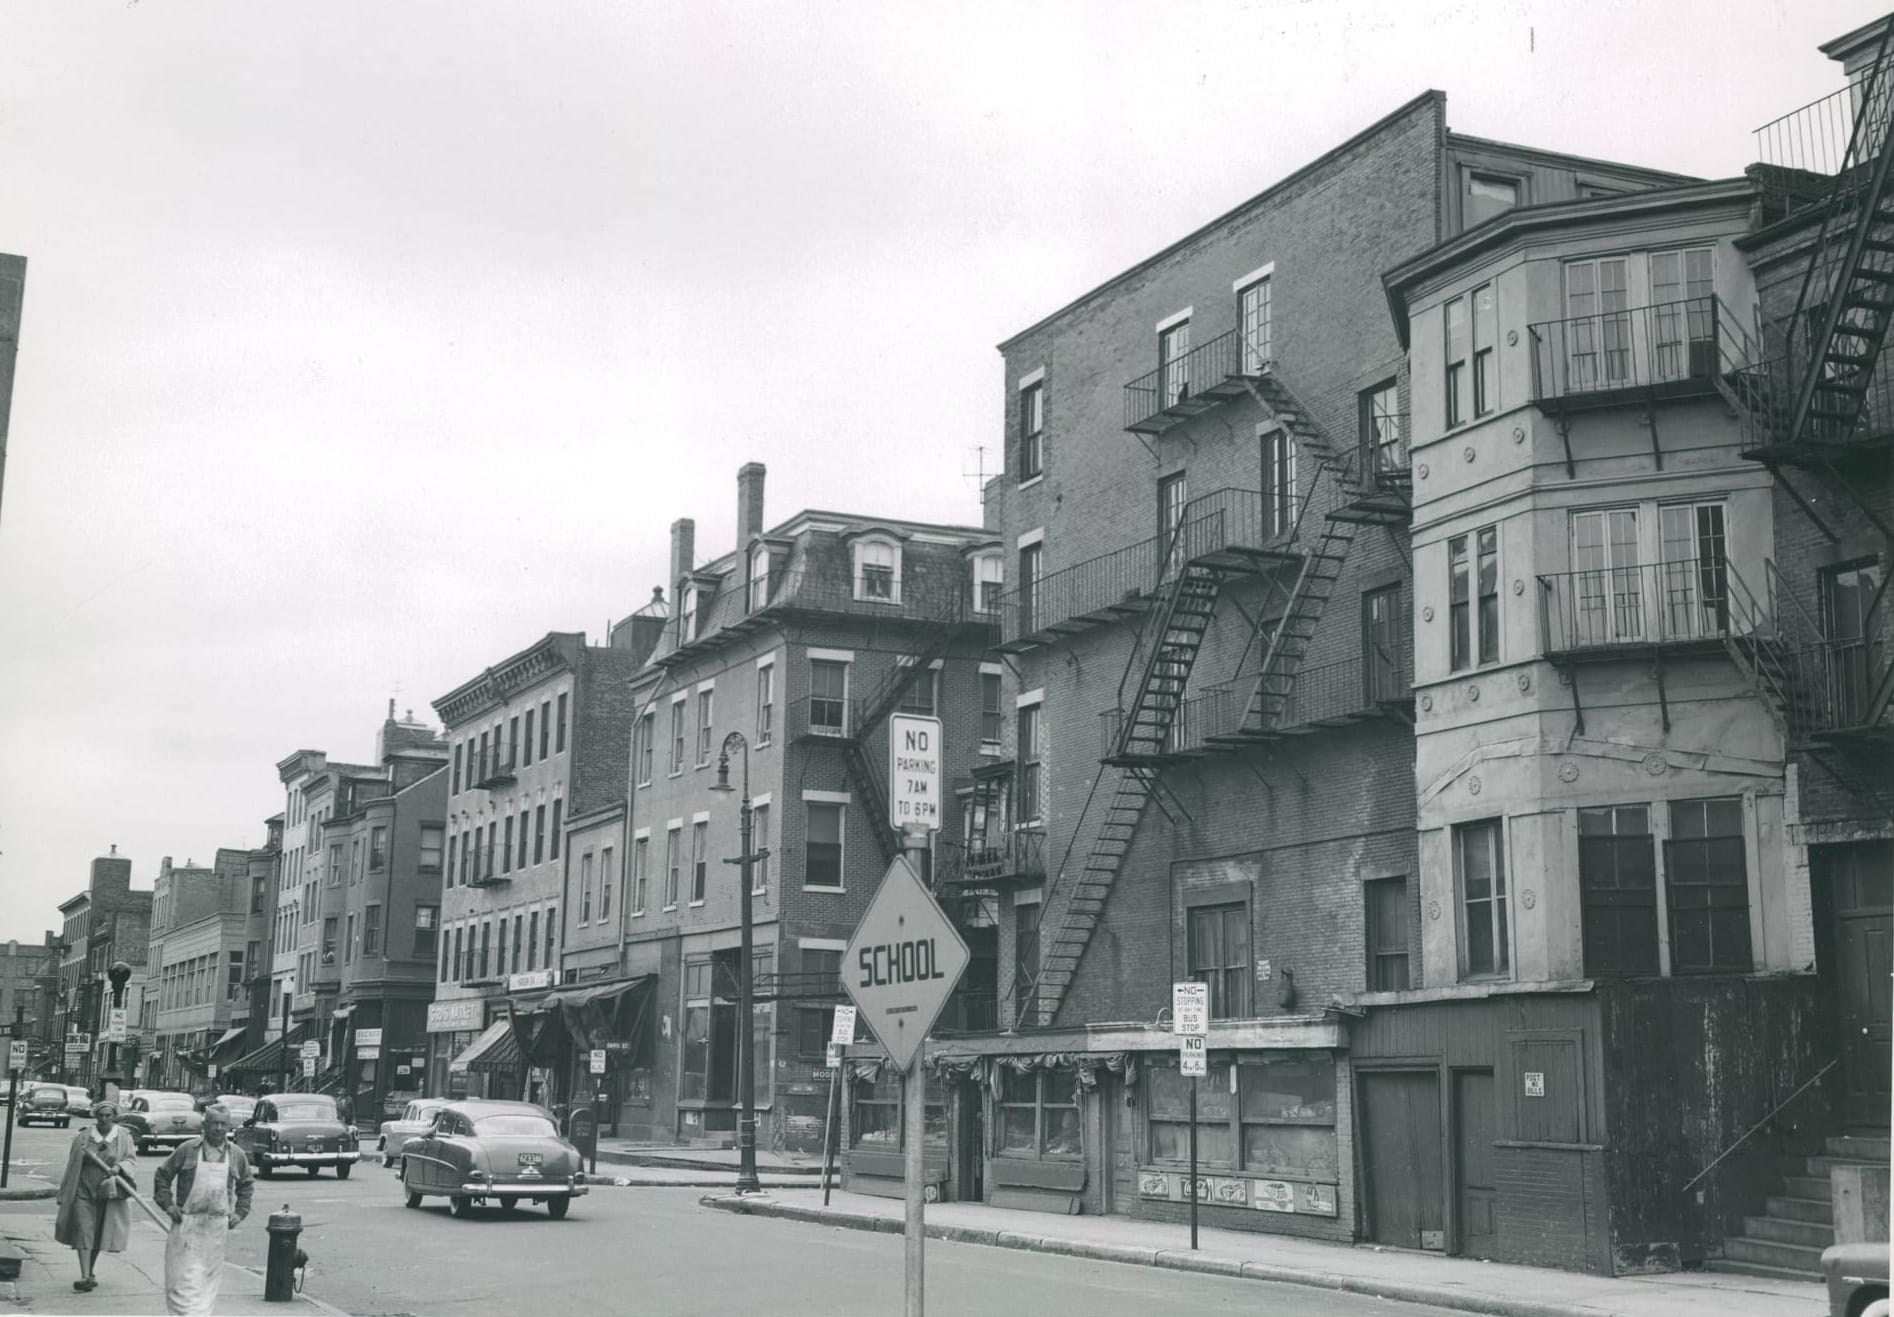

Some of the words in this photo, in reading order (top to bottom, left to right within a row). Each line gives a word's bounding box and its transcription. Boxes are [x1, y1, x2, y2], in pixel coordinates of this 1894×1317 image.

[905, 730, 928, 752] NO
[897, 757, 936, 774] PARKING
[907, 779, 928, 794] 7AM
[898, 801, 910, 815] TO
[914, 802, 936, 816] 6PM
[859, 938, 945, 988] SCHOOL
[1184, 986, 1197, 995] NO
[1176, 996, 1204, 1006] STOPPING
[1183, 1014, 1198, 1023] BUS
[1181, 1023, 1200, 1032] STOP
[12, 1044, 25, 1054] NO
[1186, 1039, 1201, 1049] NO
